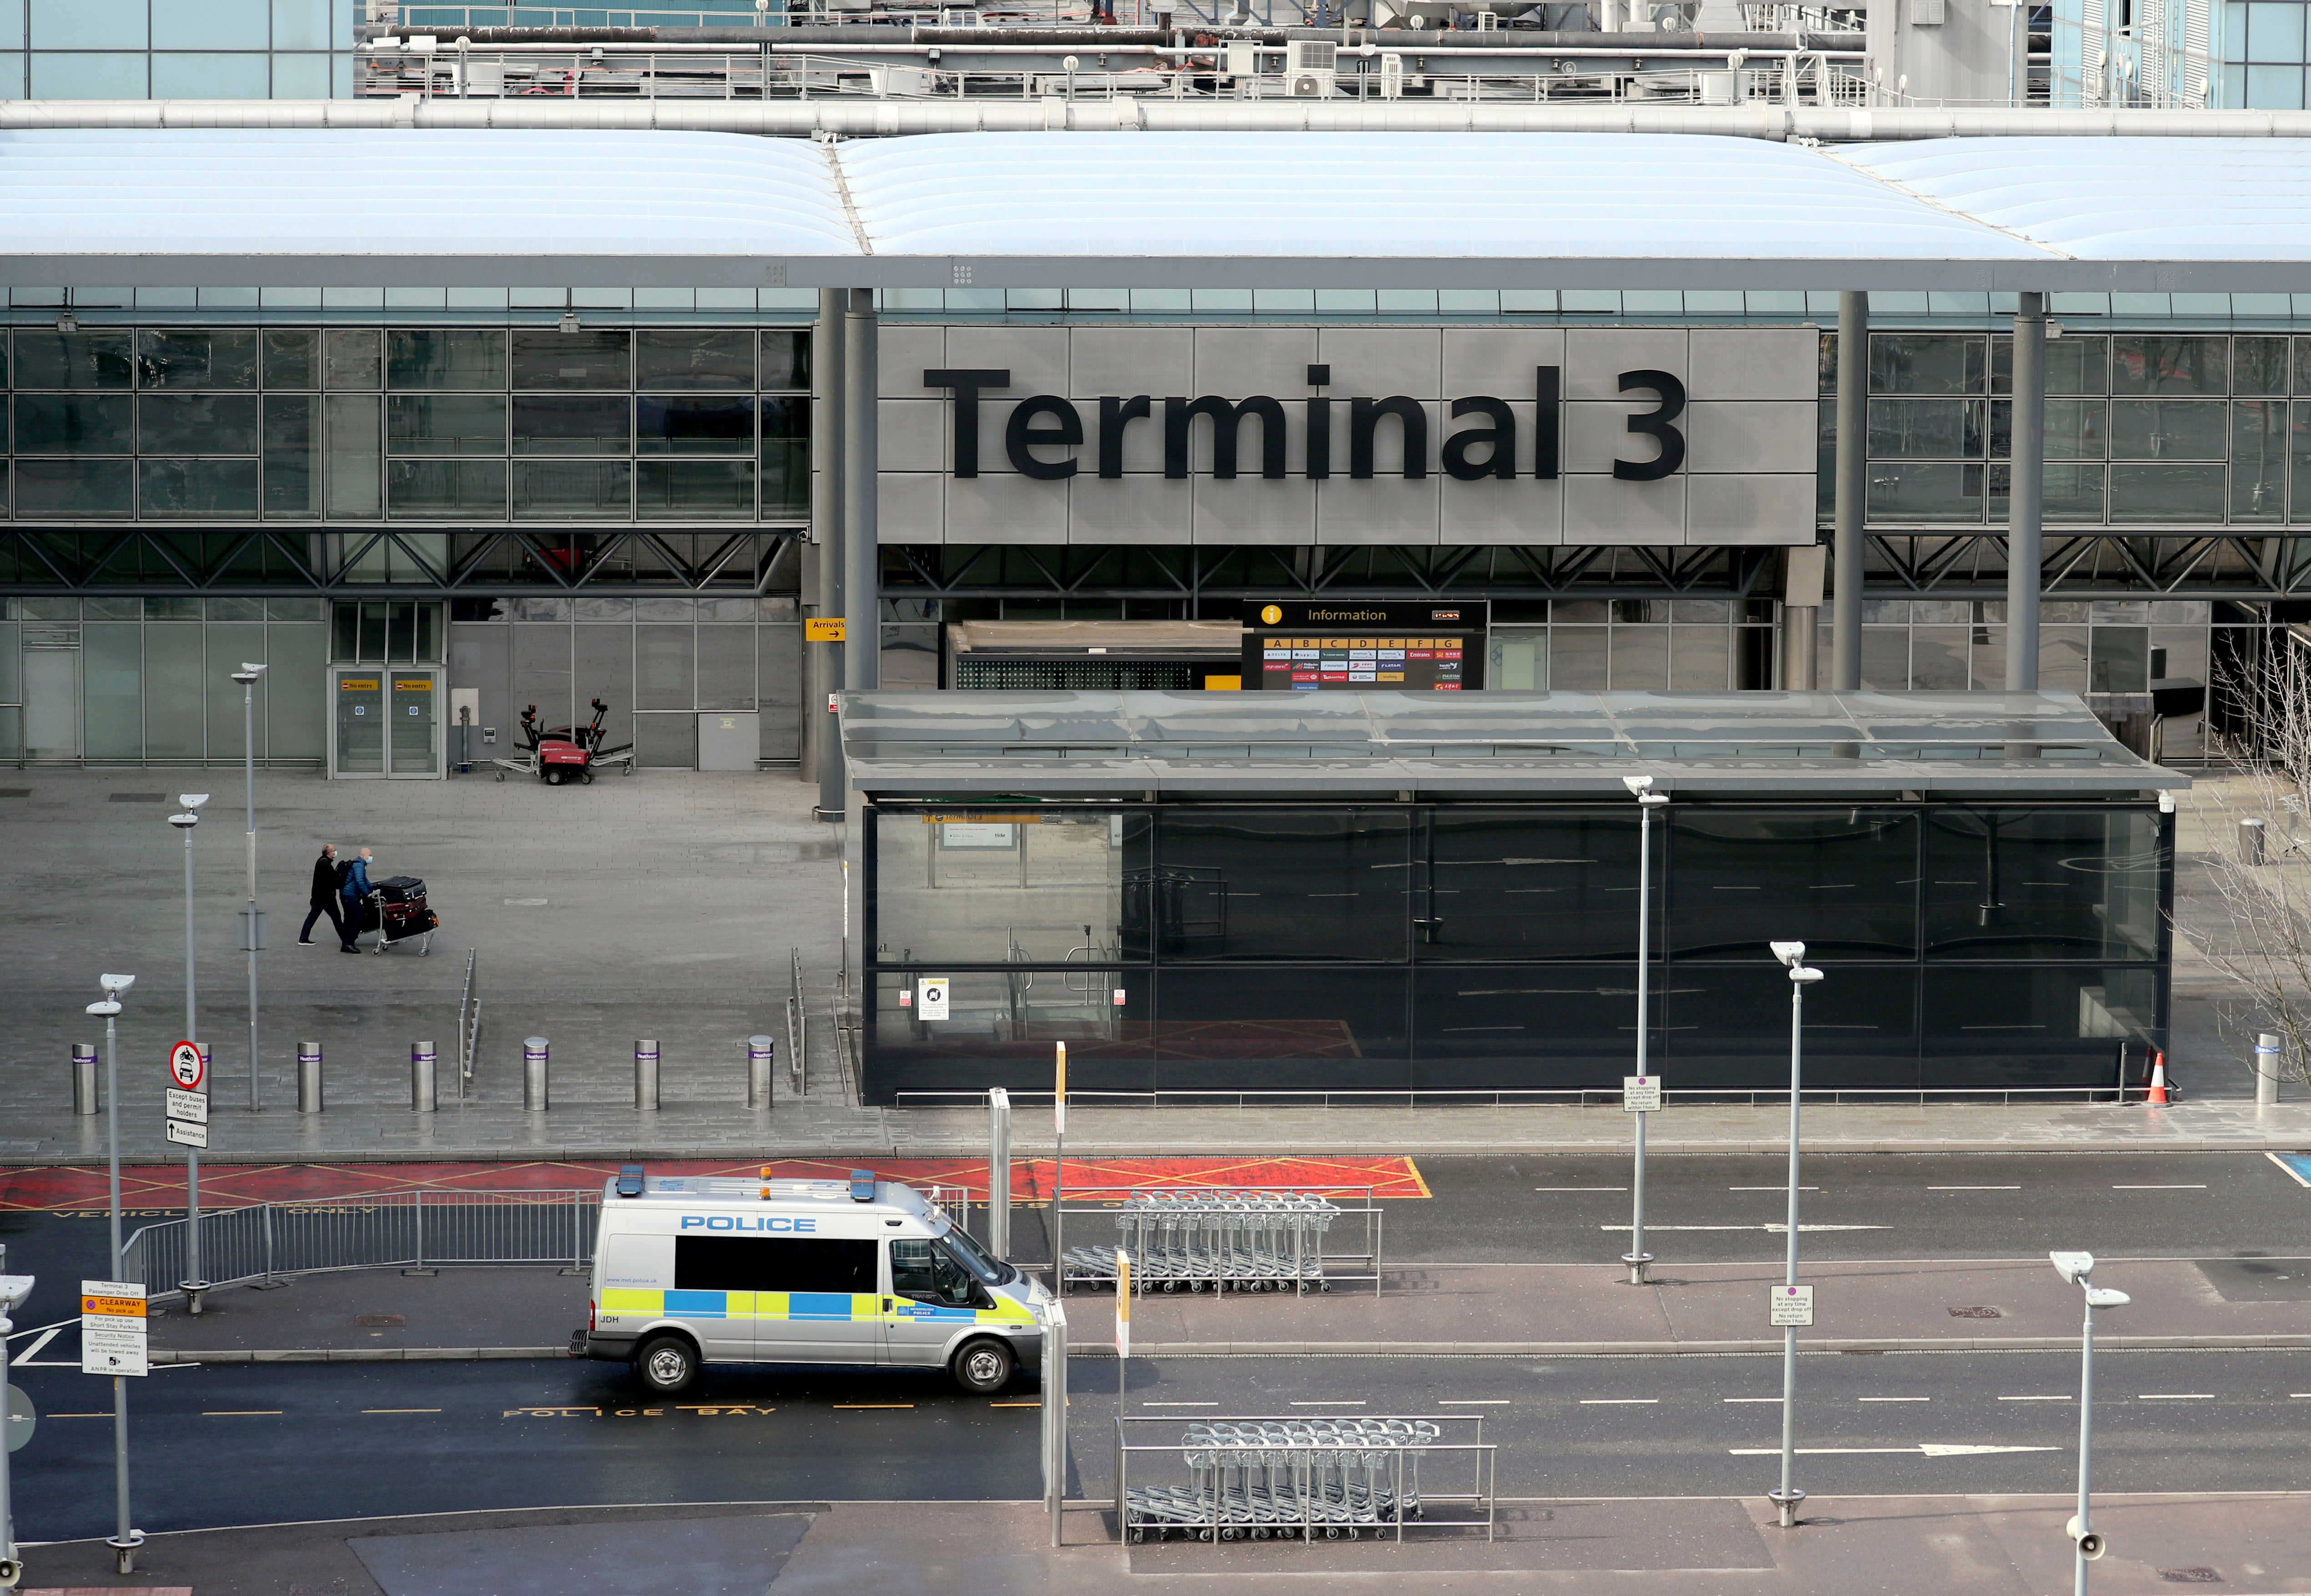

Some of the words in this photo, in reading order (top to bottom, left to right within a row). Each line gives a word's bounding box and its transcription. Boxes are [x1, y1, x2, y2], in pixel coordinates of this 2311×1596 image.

[923, 364, 1560, 481] Terminal
[1613, 369, 1687, 481] 3
[1308, 609, 1386, 620] Information
[169, 1091, 188, 1100] Except
[189, 1095, 205, 1104] buses
[184, 1103, 202, 1111] permit
[177, 1109, 197, 1118] holders
[176, 1127, 205, 1139] Assistance
[681, 1216, 816, 1232] POLICE
[100, 1299, 141, 1307] CLEARWAY
[503, 1409, 664, 1417] POLICE
[697, 1408, 776, 1416] BAY
